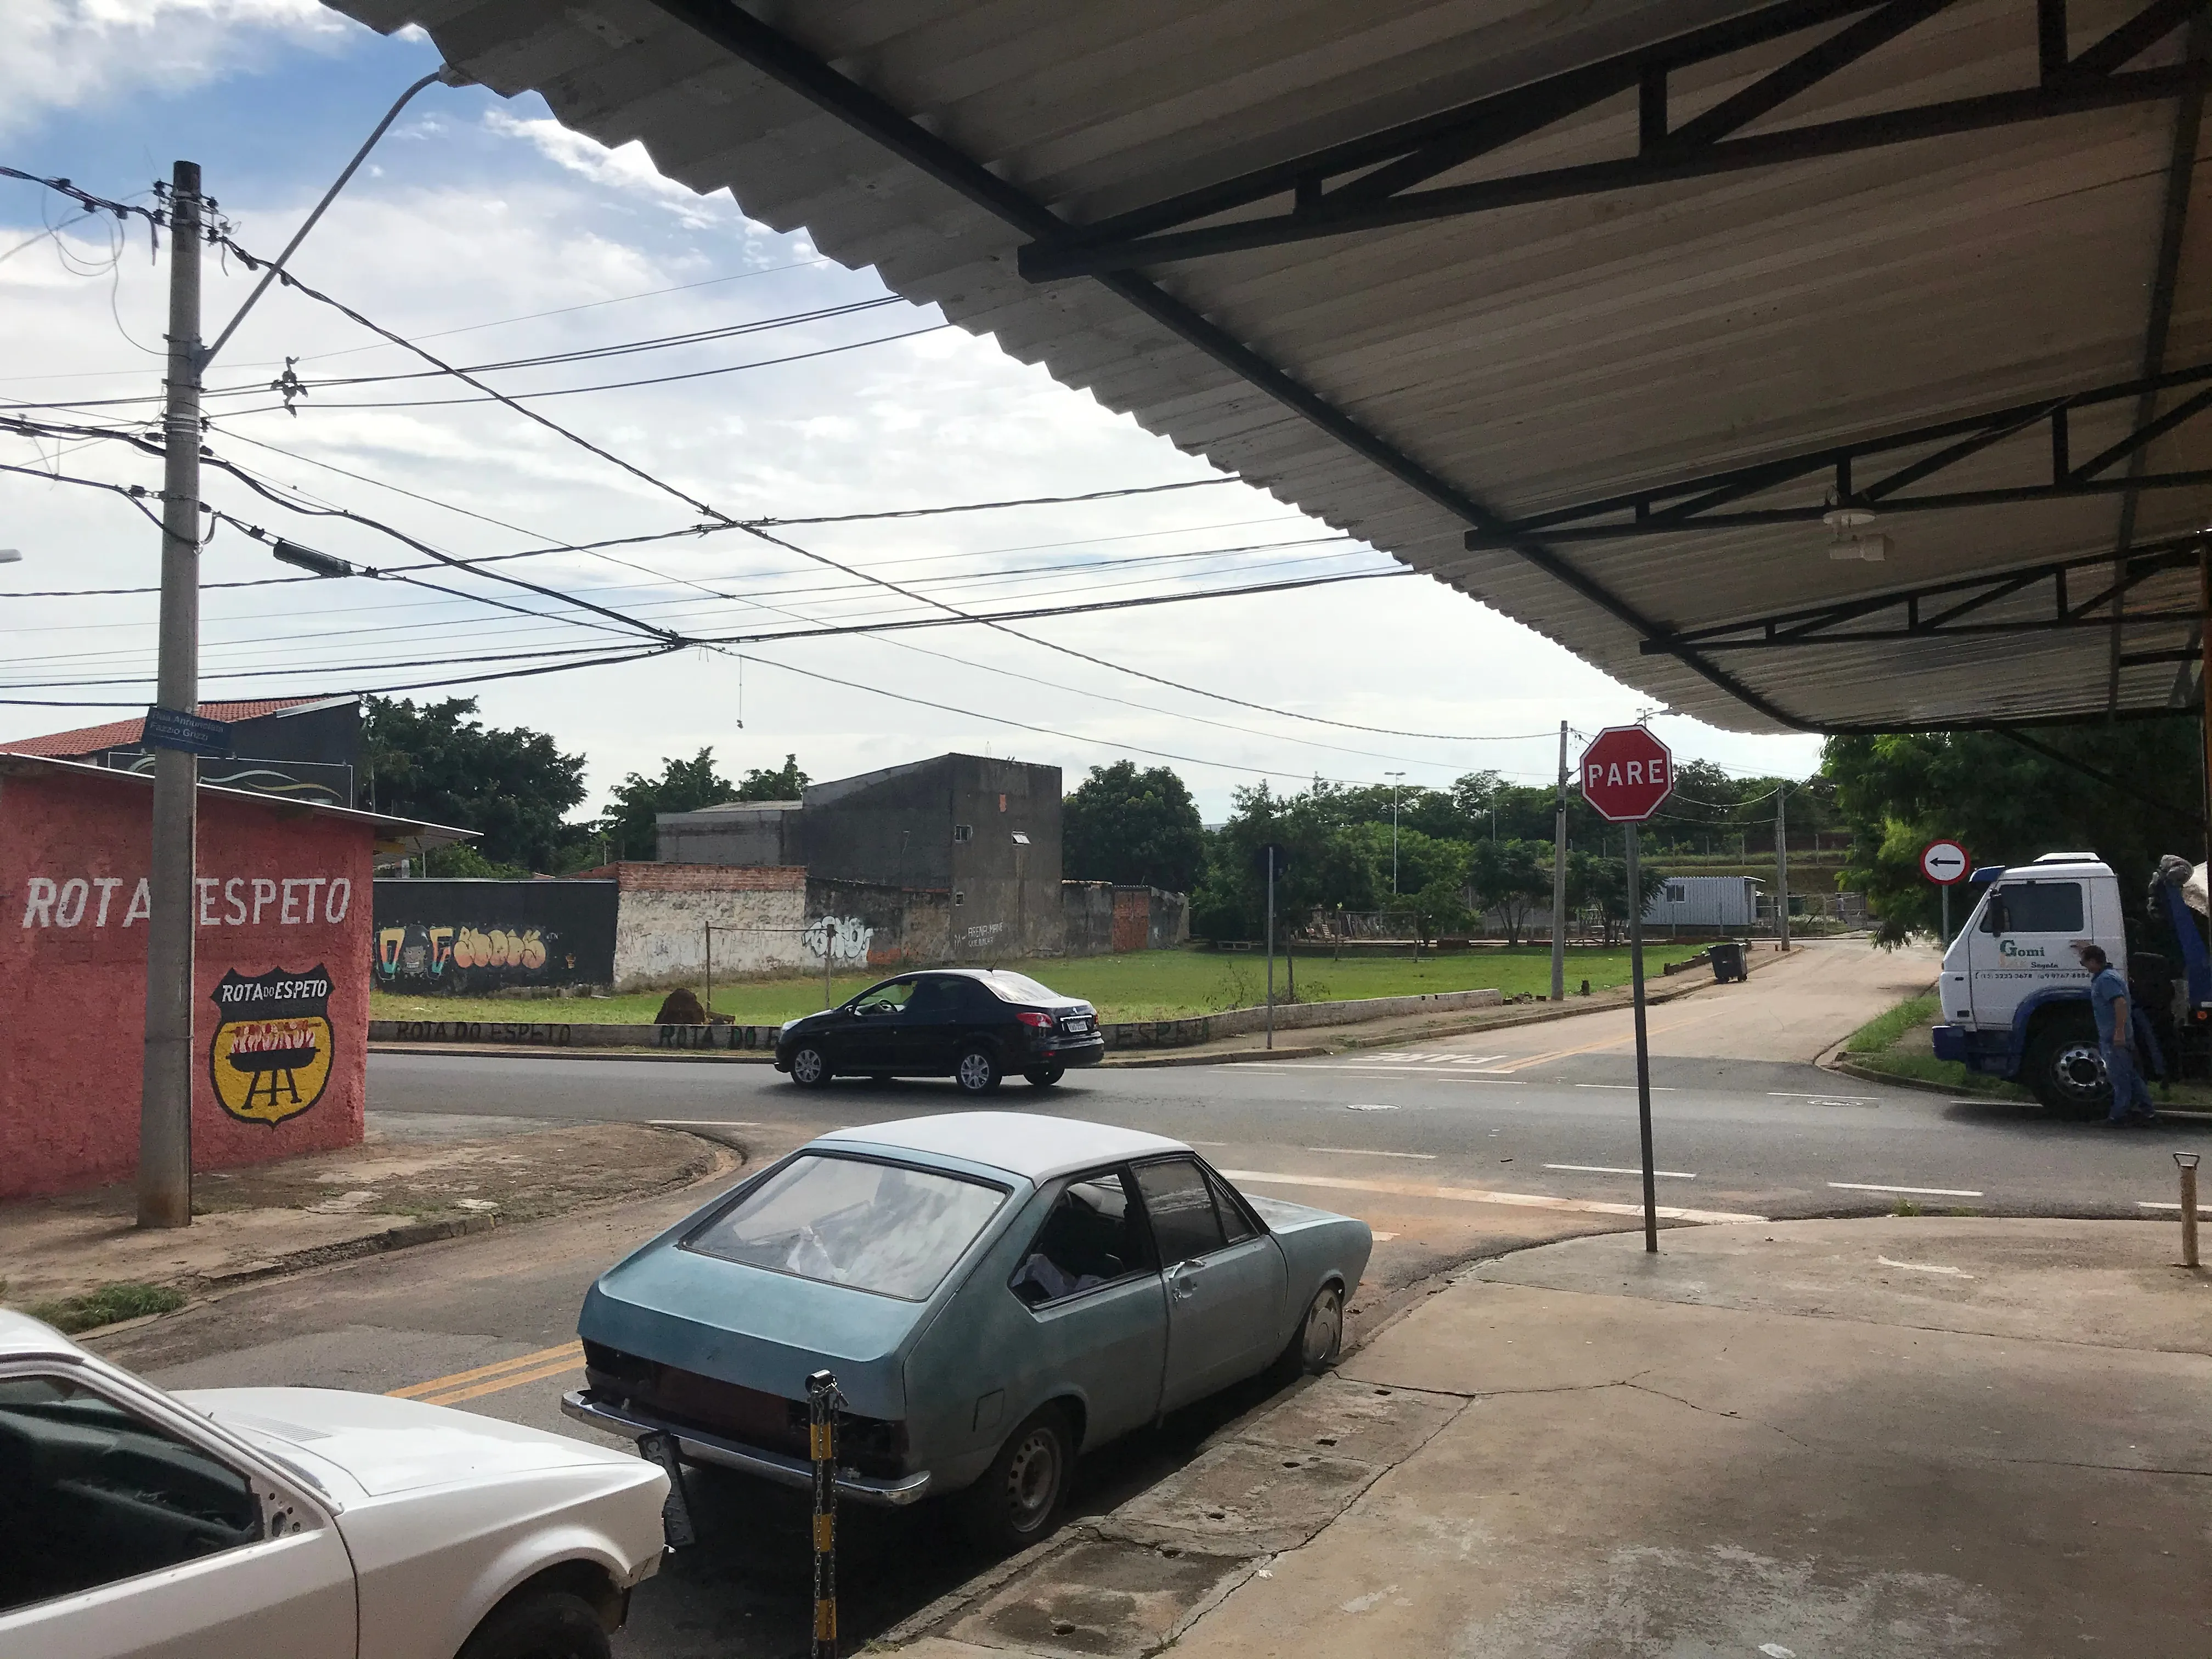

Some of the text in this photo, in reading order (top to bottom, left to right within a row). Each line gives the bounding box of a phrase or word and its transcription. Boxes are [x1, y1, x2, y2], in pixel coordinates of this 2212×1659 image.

[1588, 759, 1664, 788] PARE
[22, 877, 352, 928] ROTA ESPETO
[2000, 939, 2045, 957] Gomi
[222, 979, 328, 1002] ROTA DO ESPETO
[397, 1023, 446, 1040] ROTA
[661, 1025, 714, 1049] ROTA
